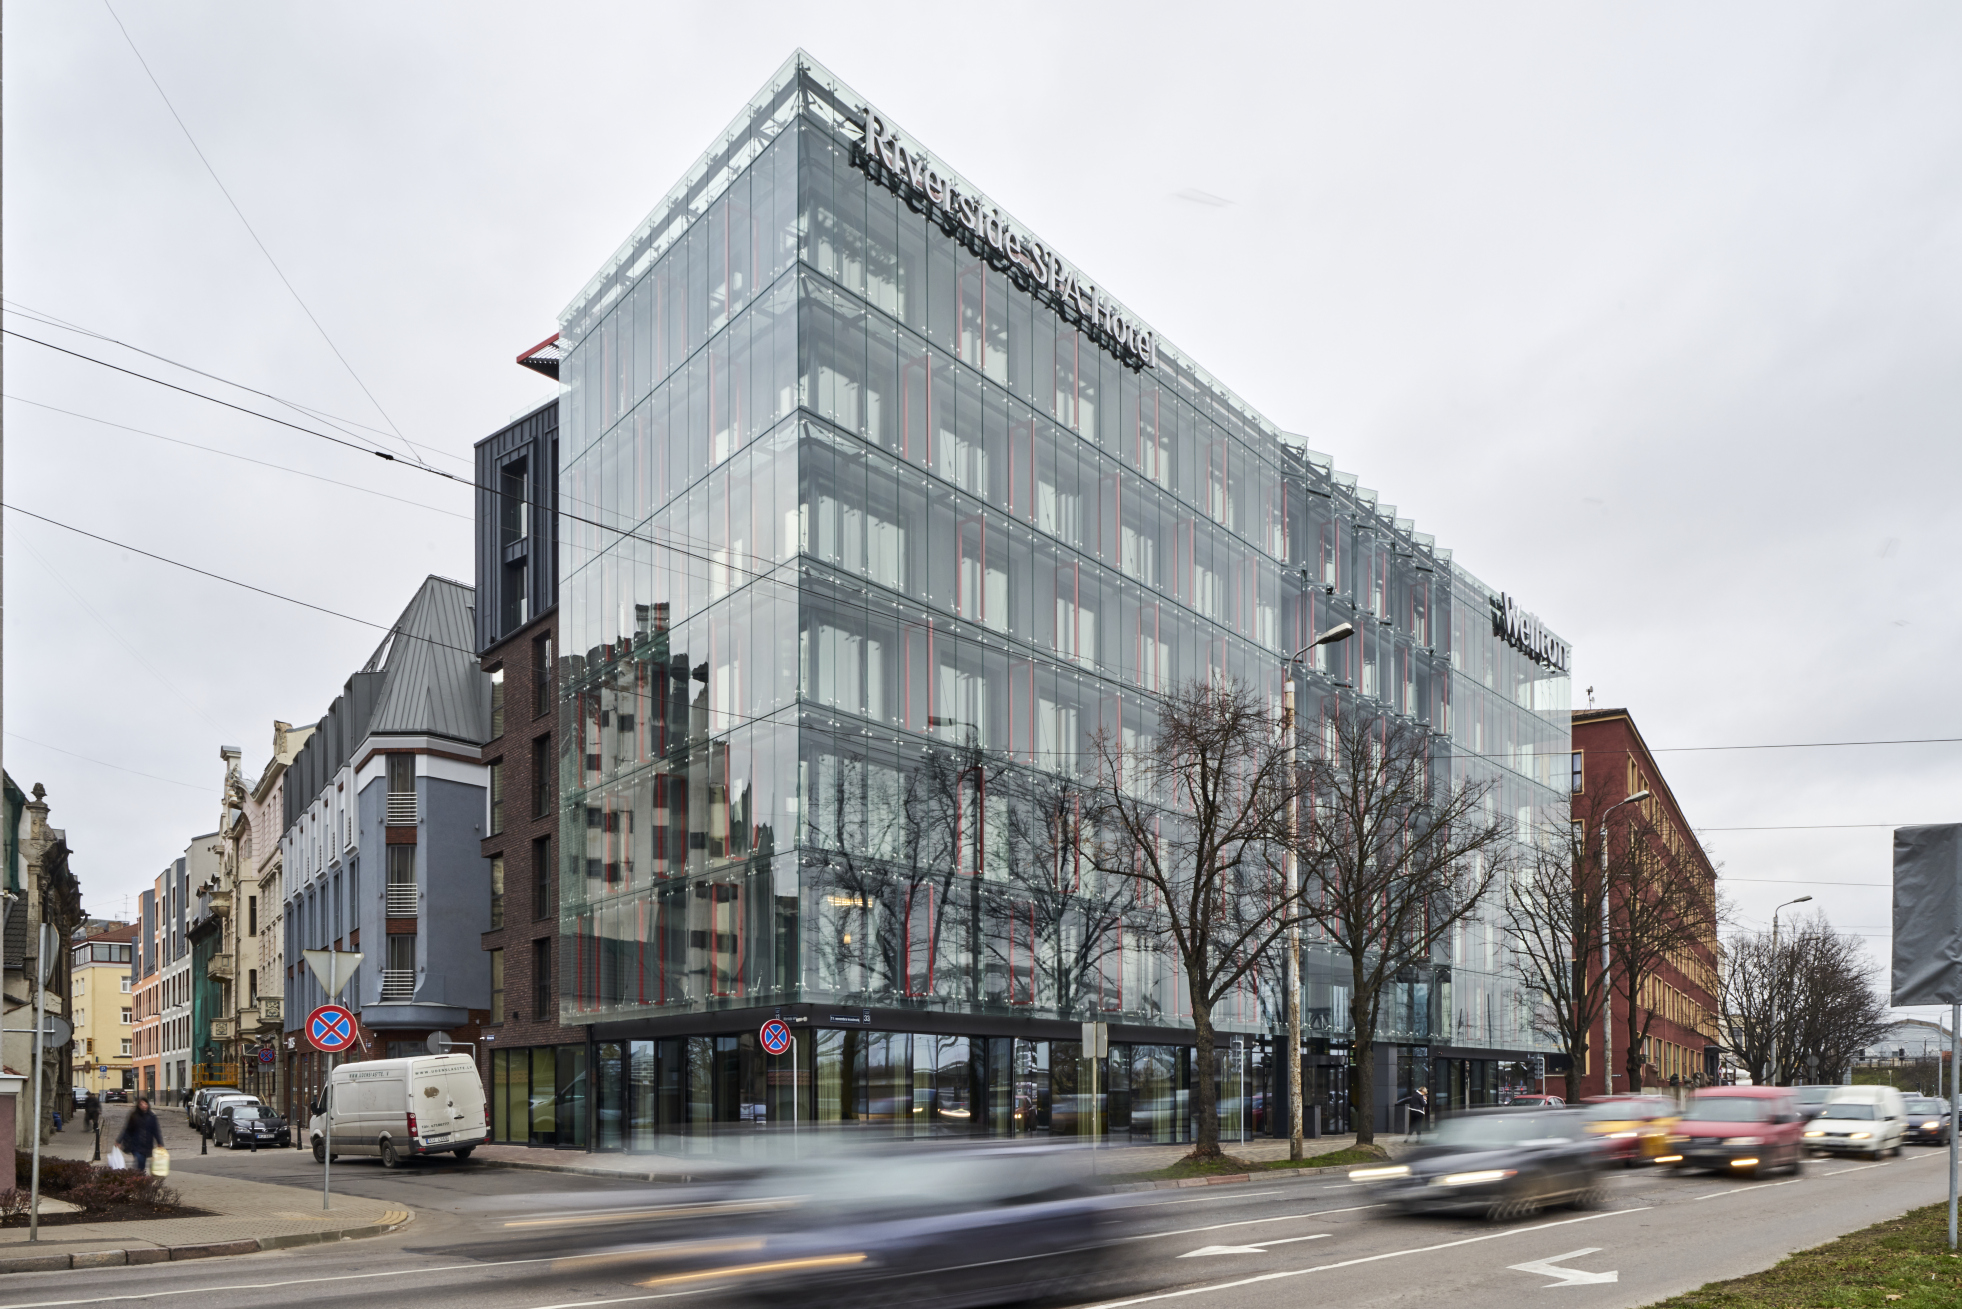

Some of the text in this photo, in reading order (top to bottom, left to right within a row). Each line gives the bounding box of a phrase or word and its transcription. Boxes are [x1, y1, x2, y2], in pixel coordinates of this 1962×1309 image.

[863, 107, 1156, 369] Riverside SPA Hotel
[1501, 591, 1568, 671] Wellton
